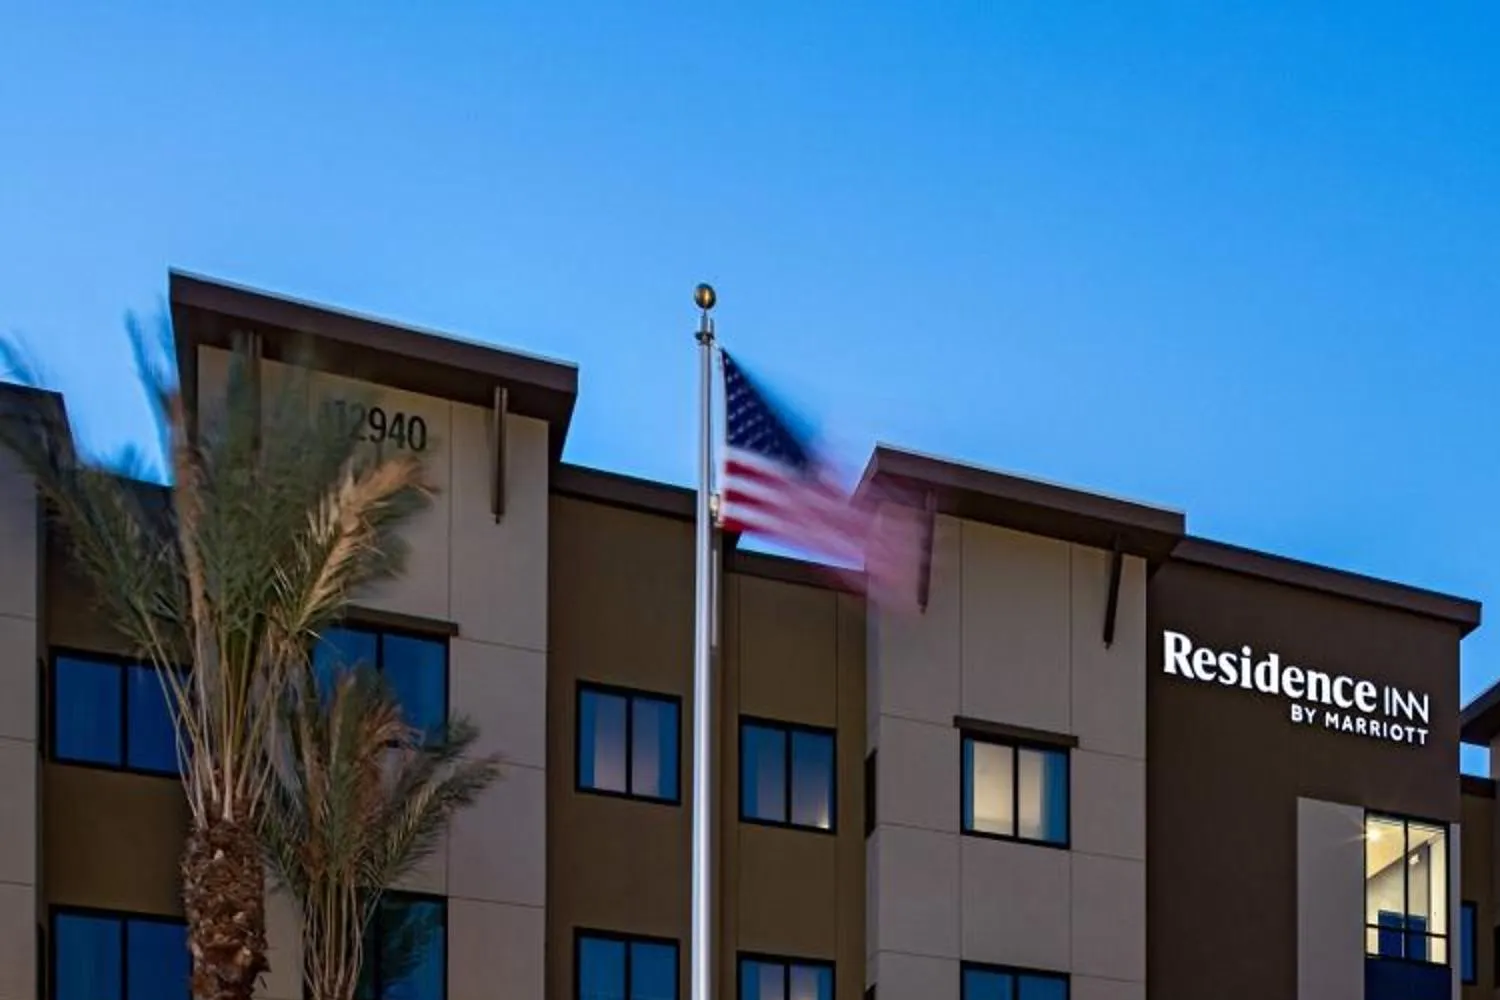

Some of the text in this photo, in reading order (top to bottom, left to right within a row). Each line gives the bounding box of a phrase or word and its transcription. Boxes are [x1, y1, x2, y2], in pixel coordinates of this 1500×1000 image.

[1163, 630, 1429, 724] Residence INN
[1291, 703, 1429, 745] BY MARRIOTT
